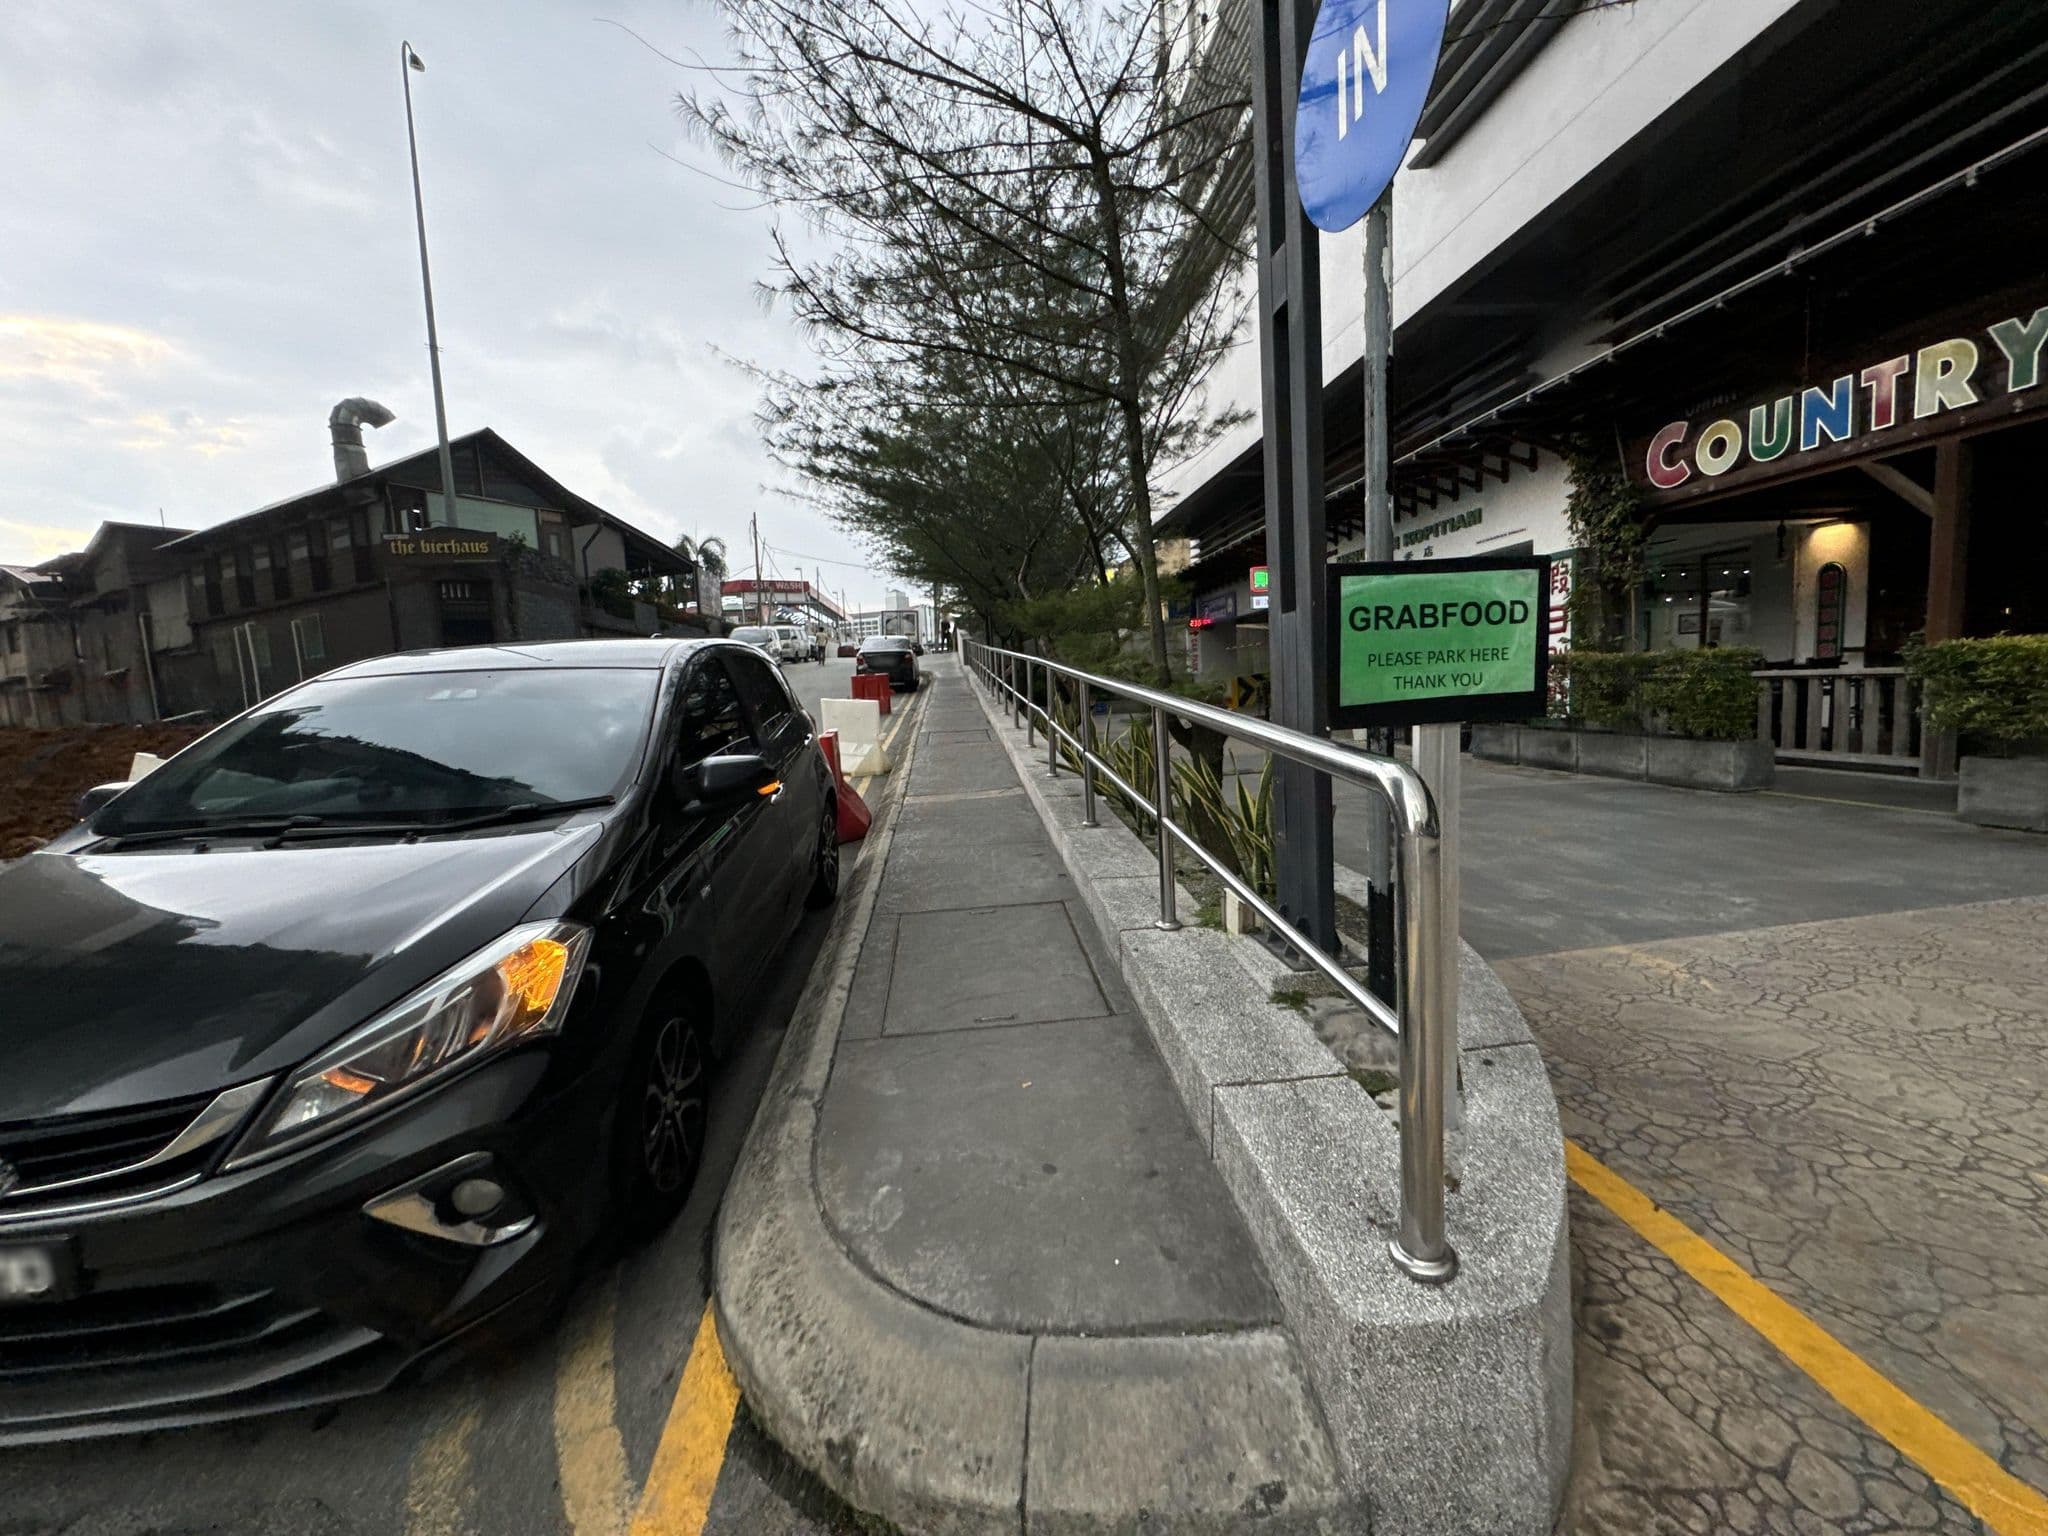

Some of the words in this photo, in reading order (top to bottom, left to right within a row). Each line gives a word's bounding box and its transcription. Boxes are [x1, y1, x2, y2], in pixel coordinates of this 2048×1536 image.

[1337, 0, 1387, 142] IN
[1646, 306, 2048, 489] COUNTRY
[390, 540, 415, 556] the
[420, 540, 489, 555] bierhaus
[1348, 600, 1529, 631] GRABFOOD
[1367, 651, 1423, 668] PLEASE
[1427, 649, 1467, 665] PARK
[1470, 647, 1510, 662] HERE
[1393, 674, 1447, 690] THANK
[1451, 672, 1484, 687] YOU
